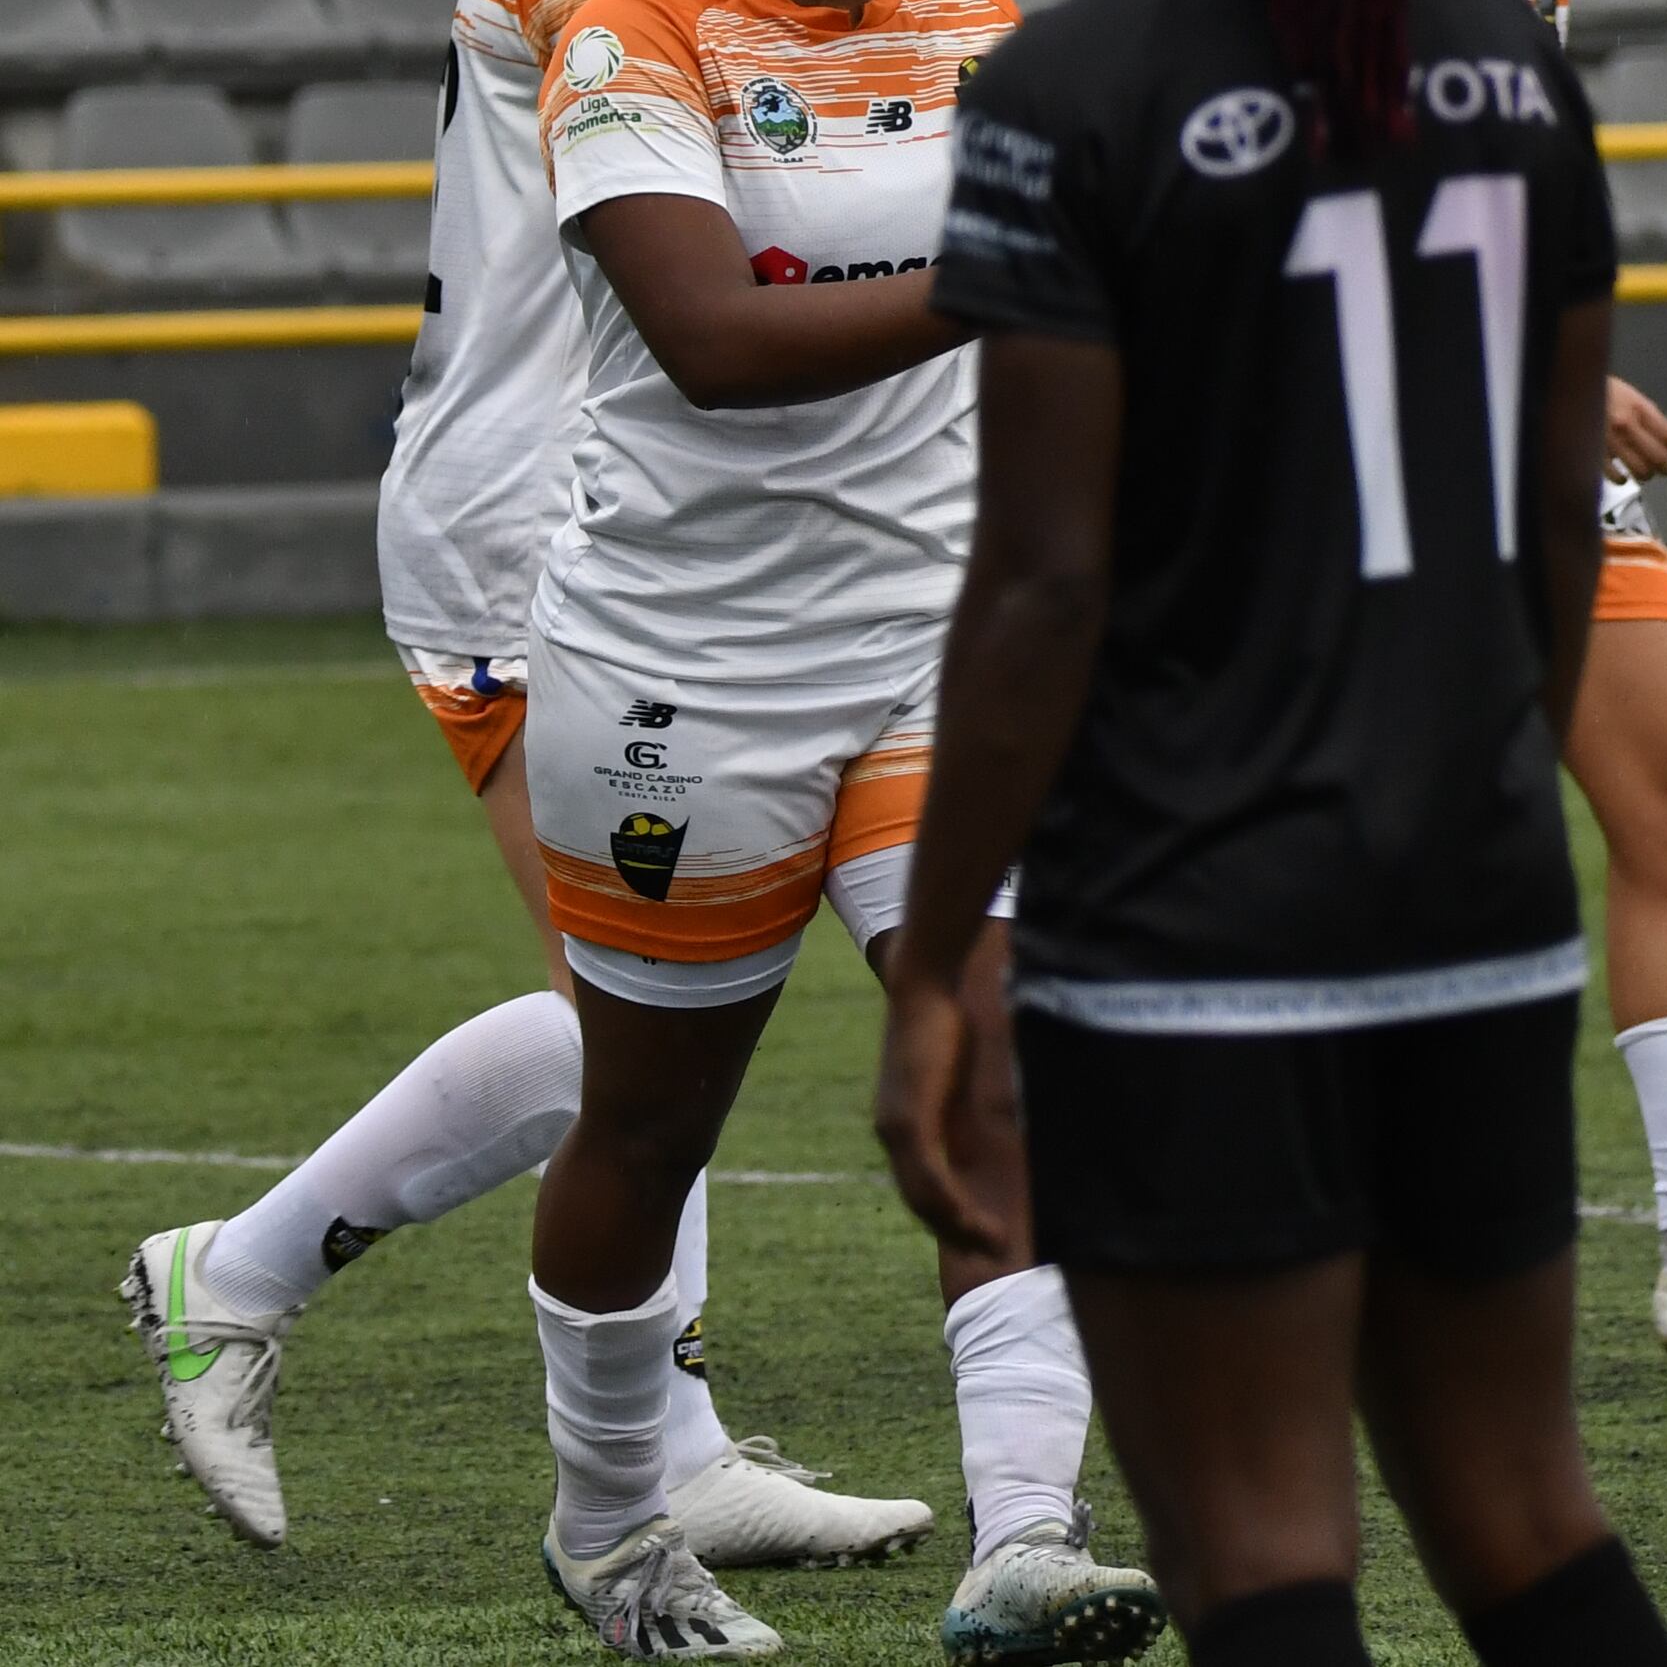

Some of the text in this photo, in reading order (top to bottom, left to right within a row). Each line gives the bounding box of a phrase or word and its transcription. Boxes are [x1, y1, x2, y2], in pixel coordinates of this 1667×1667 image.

[580, 96, 610, 114] Liga
[1281, 173, 1527, 581] 11
[594, 766, 703, 784] GRAND CASINO
